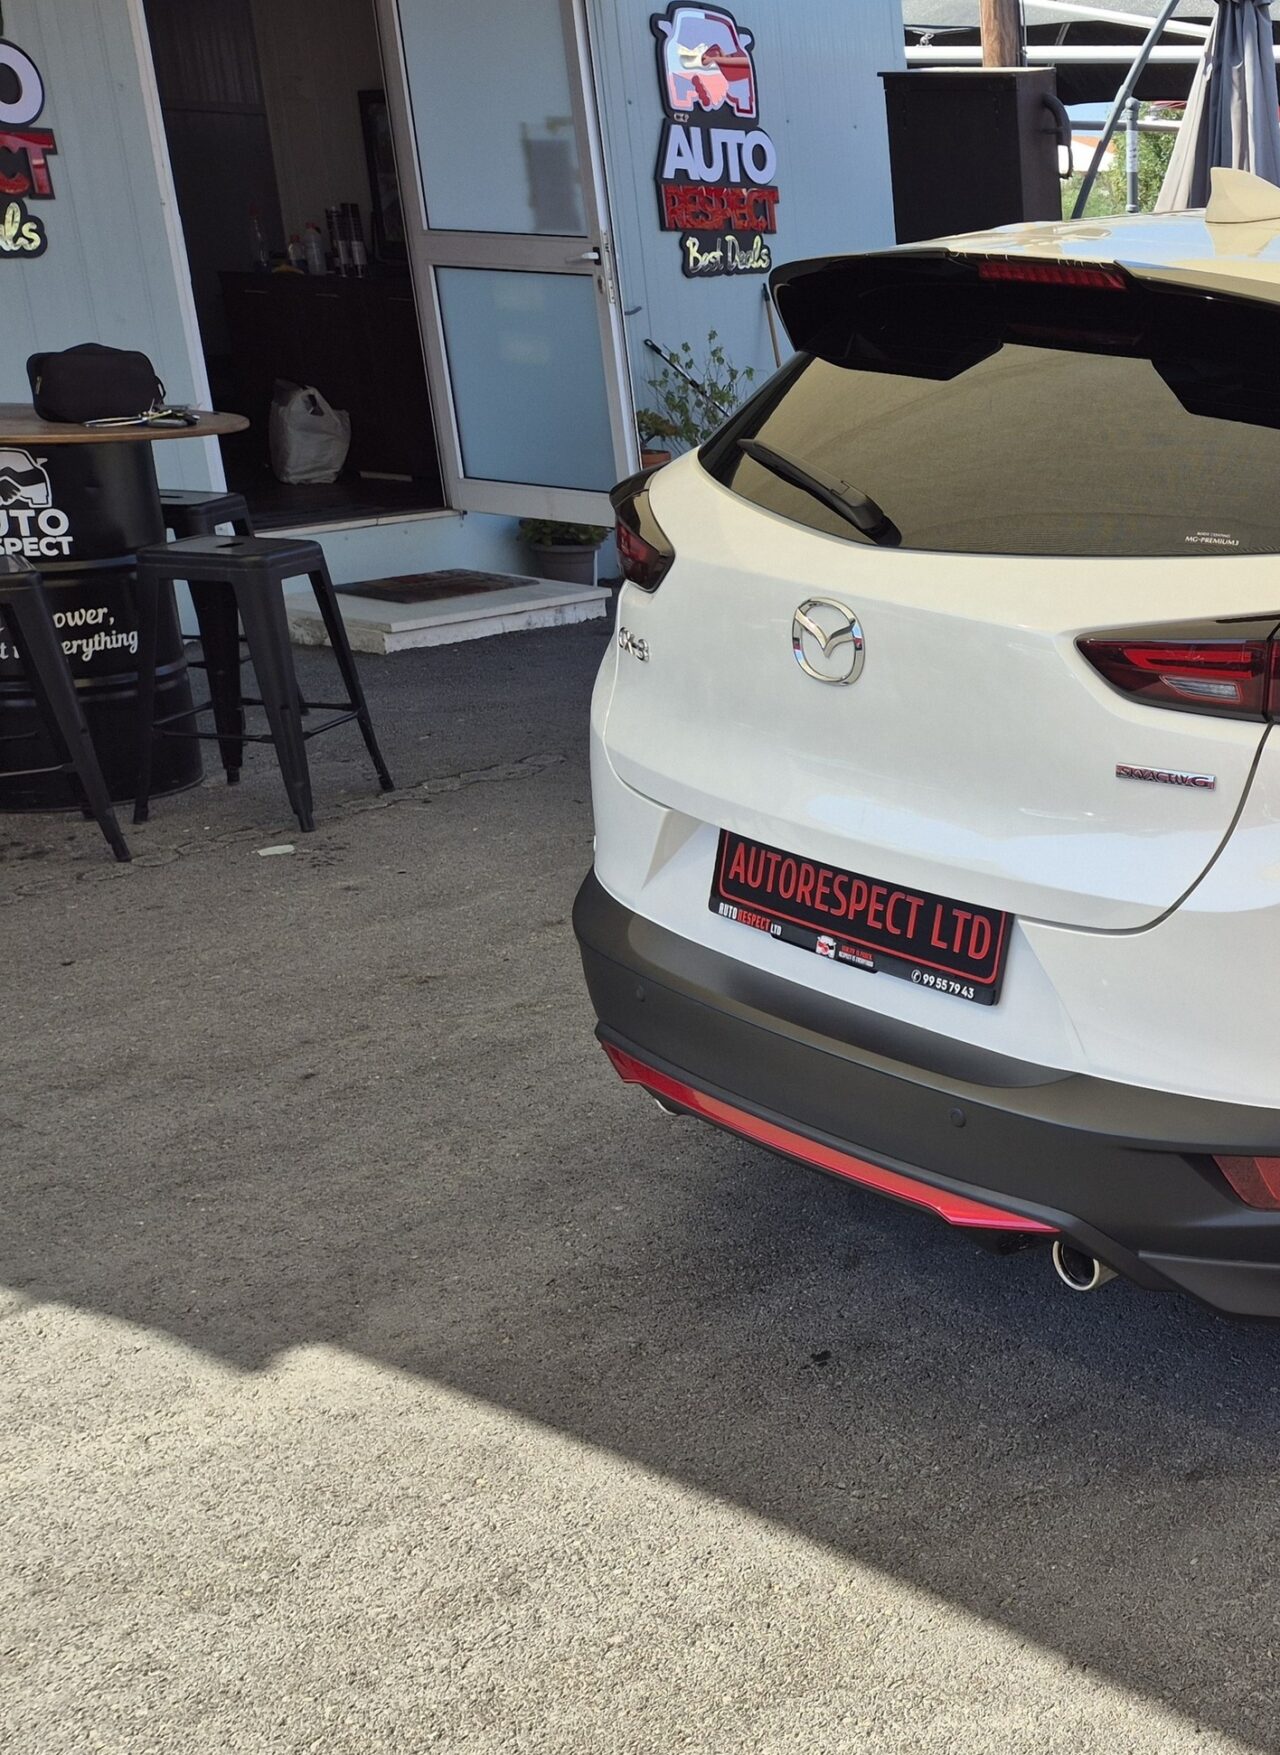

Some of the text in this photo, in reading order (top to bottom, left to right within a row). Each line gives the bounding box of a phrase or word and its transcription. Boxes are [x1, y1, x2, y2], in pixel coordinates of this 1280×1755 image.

[662, 124, 777, 185] AUTO
[661, 184, 779, 233] RESPECT
[685, 235, 770, 273] Best Deals
[52, 607, 115, 629] ower,
[61, 630, 139, 662] erything
[729, 841, 992, 960] AUTORESPECT LTD
[718, 902, 782, 936] AUTO RESPECT LTD
[922, 973, 975, 999] 99 55 79 43
